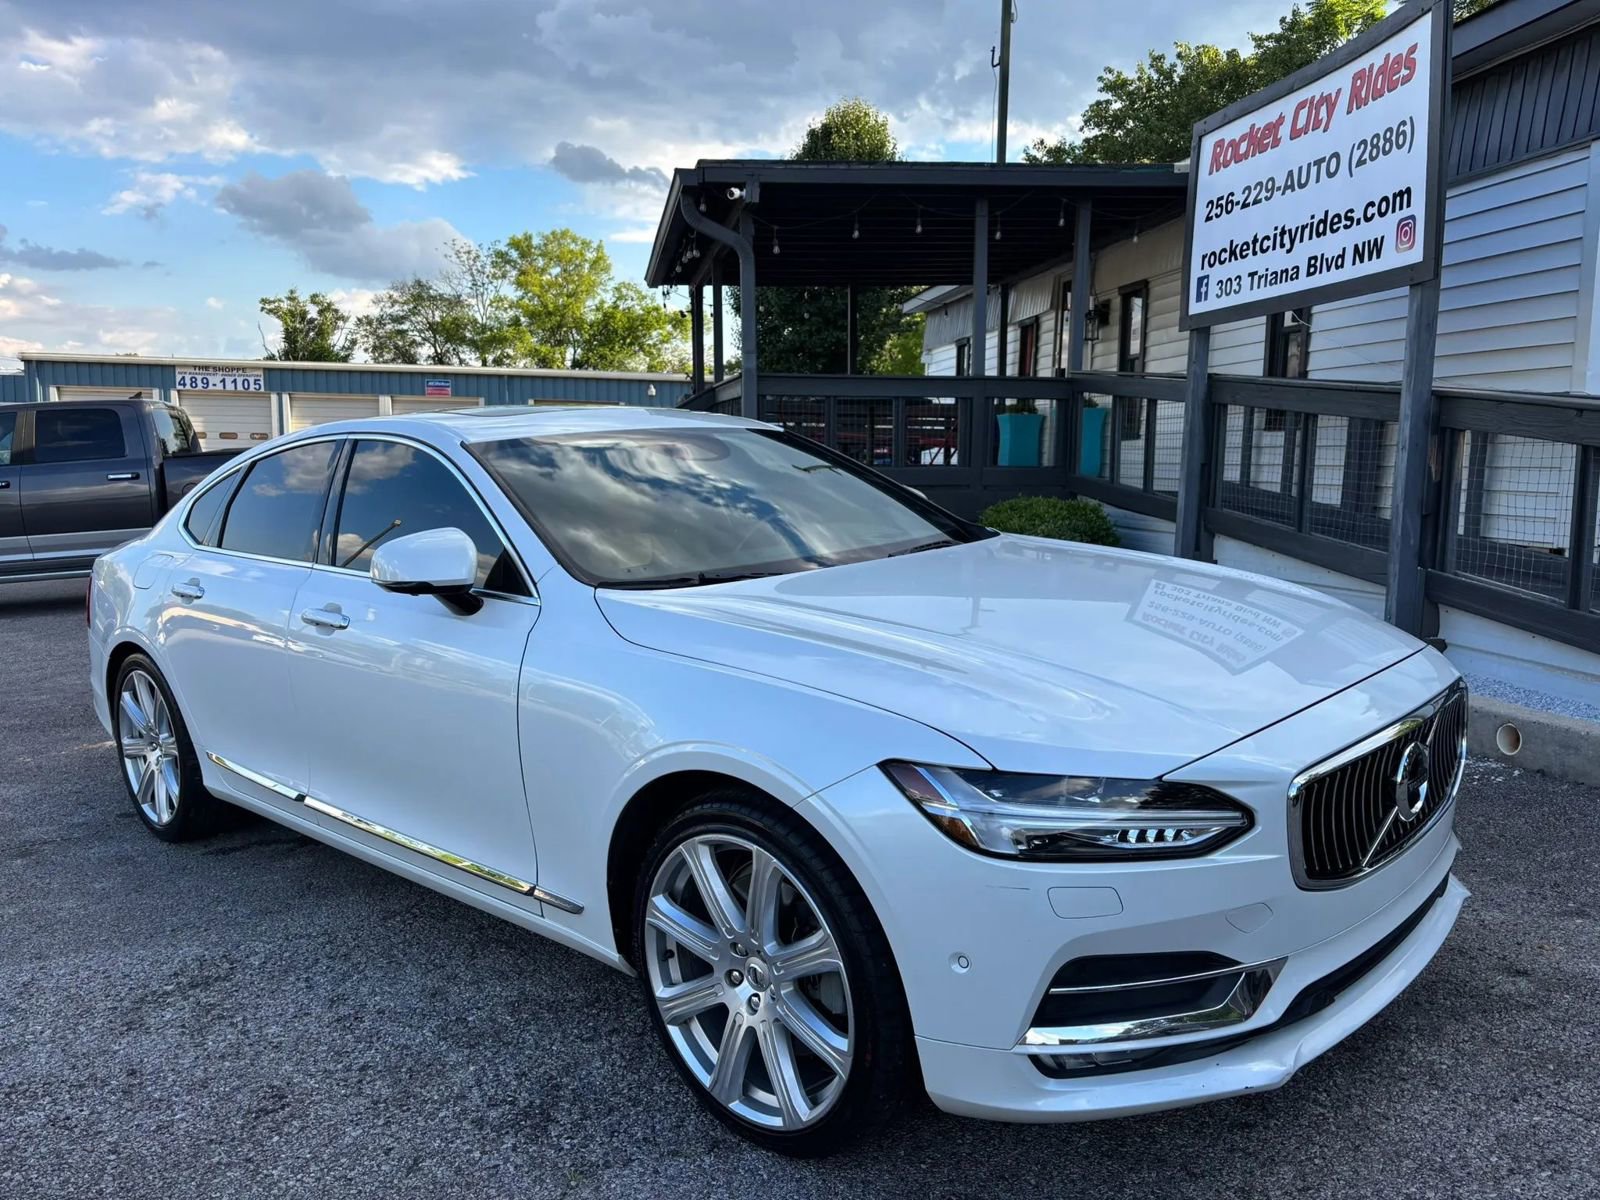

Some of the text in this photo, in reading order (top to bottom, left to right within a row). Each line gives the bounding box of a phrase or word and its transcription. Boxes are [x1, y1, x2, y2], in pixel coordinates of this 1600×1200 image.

[1208, 42, 1419, 176] Rocket City Rides
[1204, 116, 1415, 223] 256-229-AUTO (2886)
[1200, 186, 1412, 270] rocketcityrides.com
[1215, 275, 1242, 299] 303
[1248, 264, 1300, 291] Triana
[1305, 247, 1347, 278] Blvd
[1352, 235, 1385, 266] NW
[178, 375, 262, 391] 489-1105
